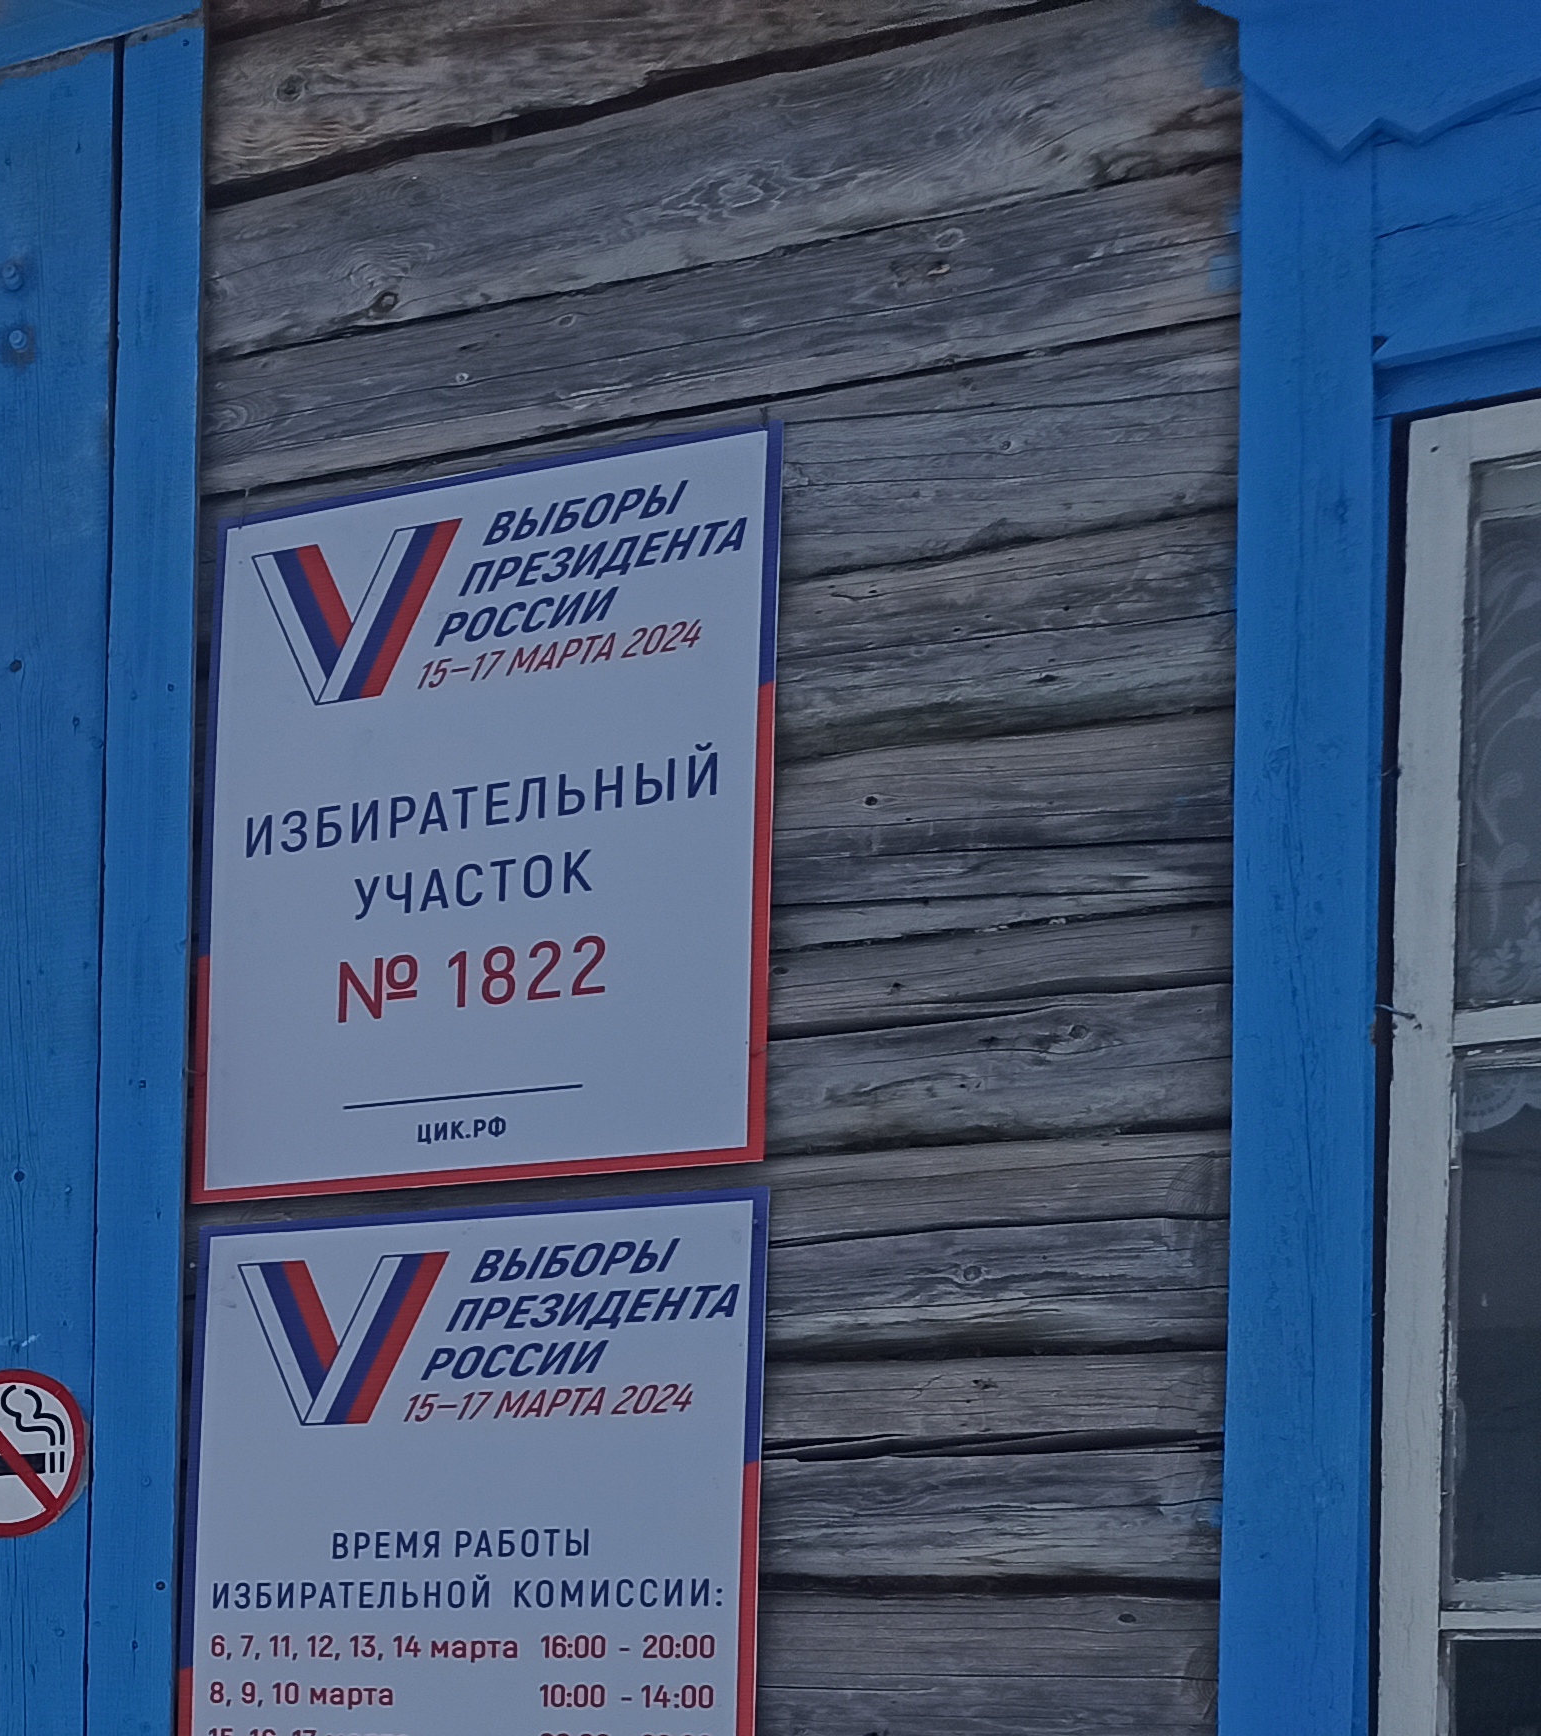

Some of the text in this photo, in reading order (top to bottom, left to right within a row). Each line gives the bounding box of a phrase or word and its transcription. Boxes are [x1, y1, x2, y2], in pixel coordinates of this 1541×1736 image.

[482, 480, 689, 547] ВЫБОРЫ
[459, 517, 749, 597] ПРЕЗИДЕНТА
[434, 586, 621, 648] РОССИИ
[505, 631, 615, 676] МАРТА
[619, 619, 702, 658] 2024
[246, 742, 718, 858] ИЗБИРАТЕЛЬНЫЙ
[354, 849, 592, 920] УЧАСТОК
[338, 935, 605, 1023] № 1822
[417, 1116, 506, 1145] ЦИК.РФ
[470, 1238, 681, 1285] ВЫБОРЫ
[445, 1283, 740, 1332] ПРЕЗИДЕНТА
[420, 1340, 609, 1381] РОССИИ
[493, 1387, 606, 1419] МАРТА
[610, 1383, 693, 1415] 2024
[332, 1528, 589, 1559] ВРЕМЯ РАБОТЫ
[213, 1574, 723, 1609] ИЗБИРАТЕЛЬНОЙ КОМИССИИ:
[211, 1635, 232, 1661] 6,
[240, 1635, 260, 1660] 7,
[269, 1635, 298, 1661] 11,
[307, 1635, 340, 1661] 12,
[349, 1635, 383, 1661] 13,
[393, 1635, 422, 1658] 14
[431, 1640, 518, 1663] марта
[541, 1635, 606, 1659] 16:00
[643, 1635, 715, 1659] 20:00
[210, 1681, 233, 1707] 8,
[241, 1682, 263, 1707] 9,
[272, 1682, 299, 1707] 10
[310, 1687, 393, 1710] марта
[540, 1684, 605, 1708] 10:00
[641, 1685, 714, 1709] 14:00
